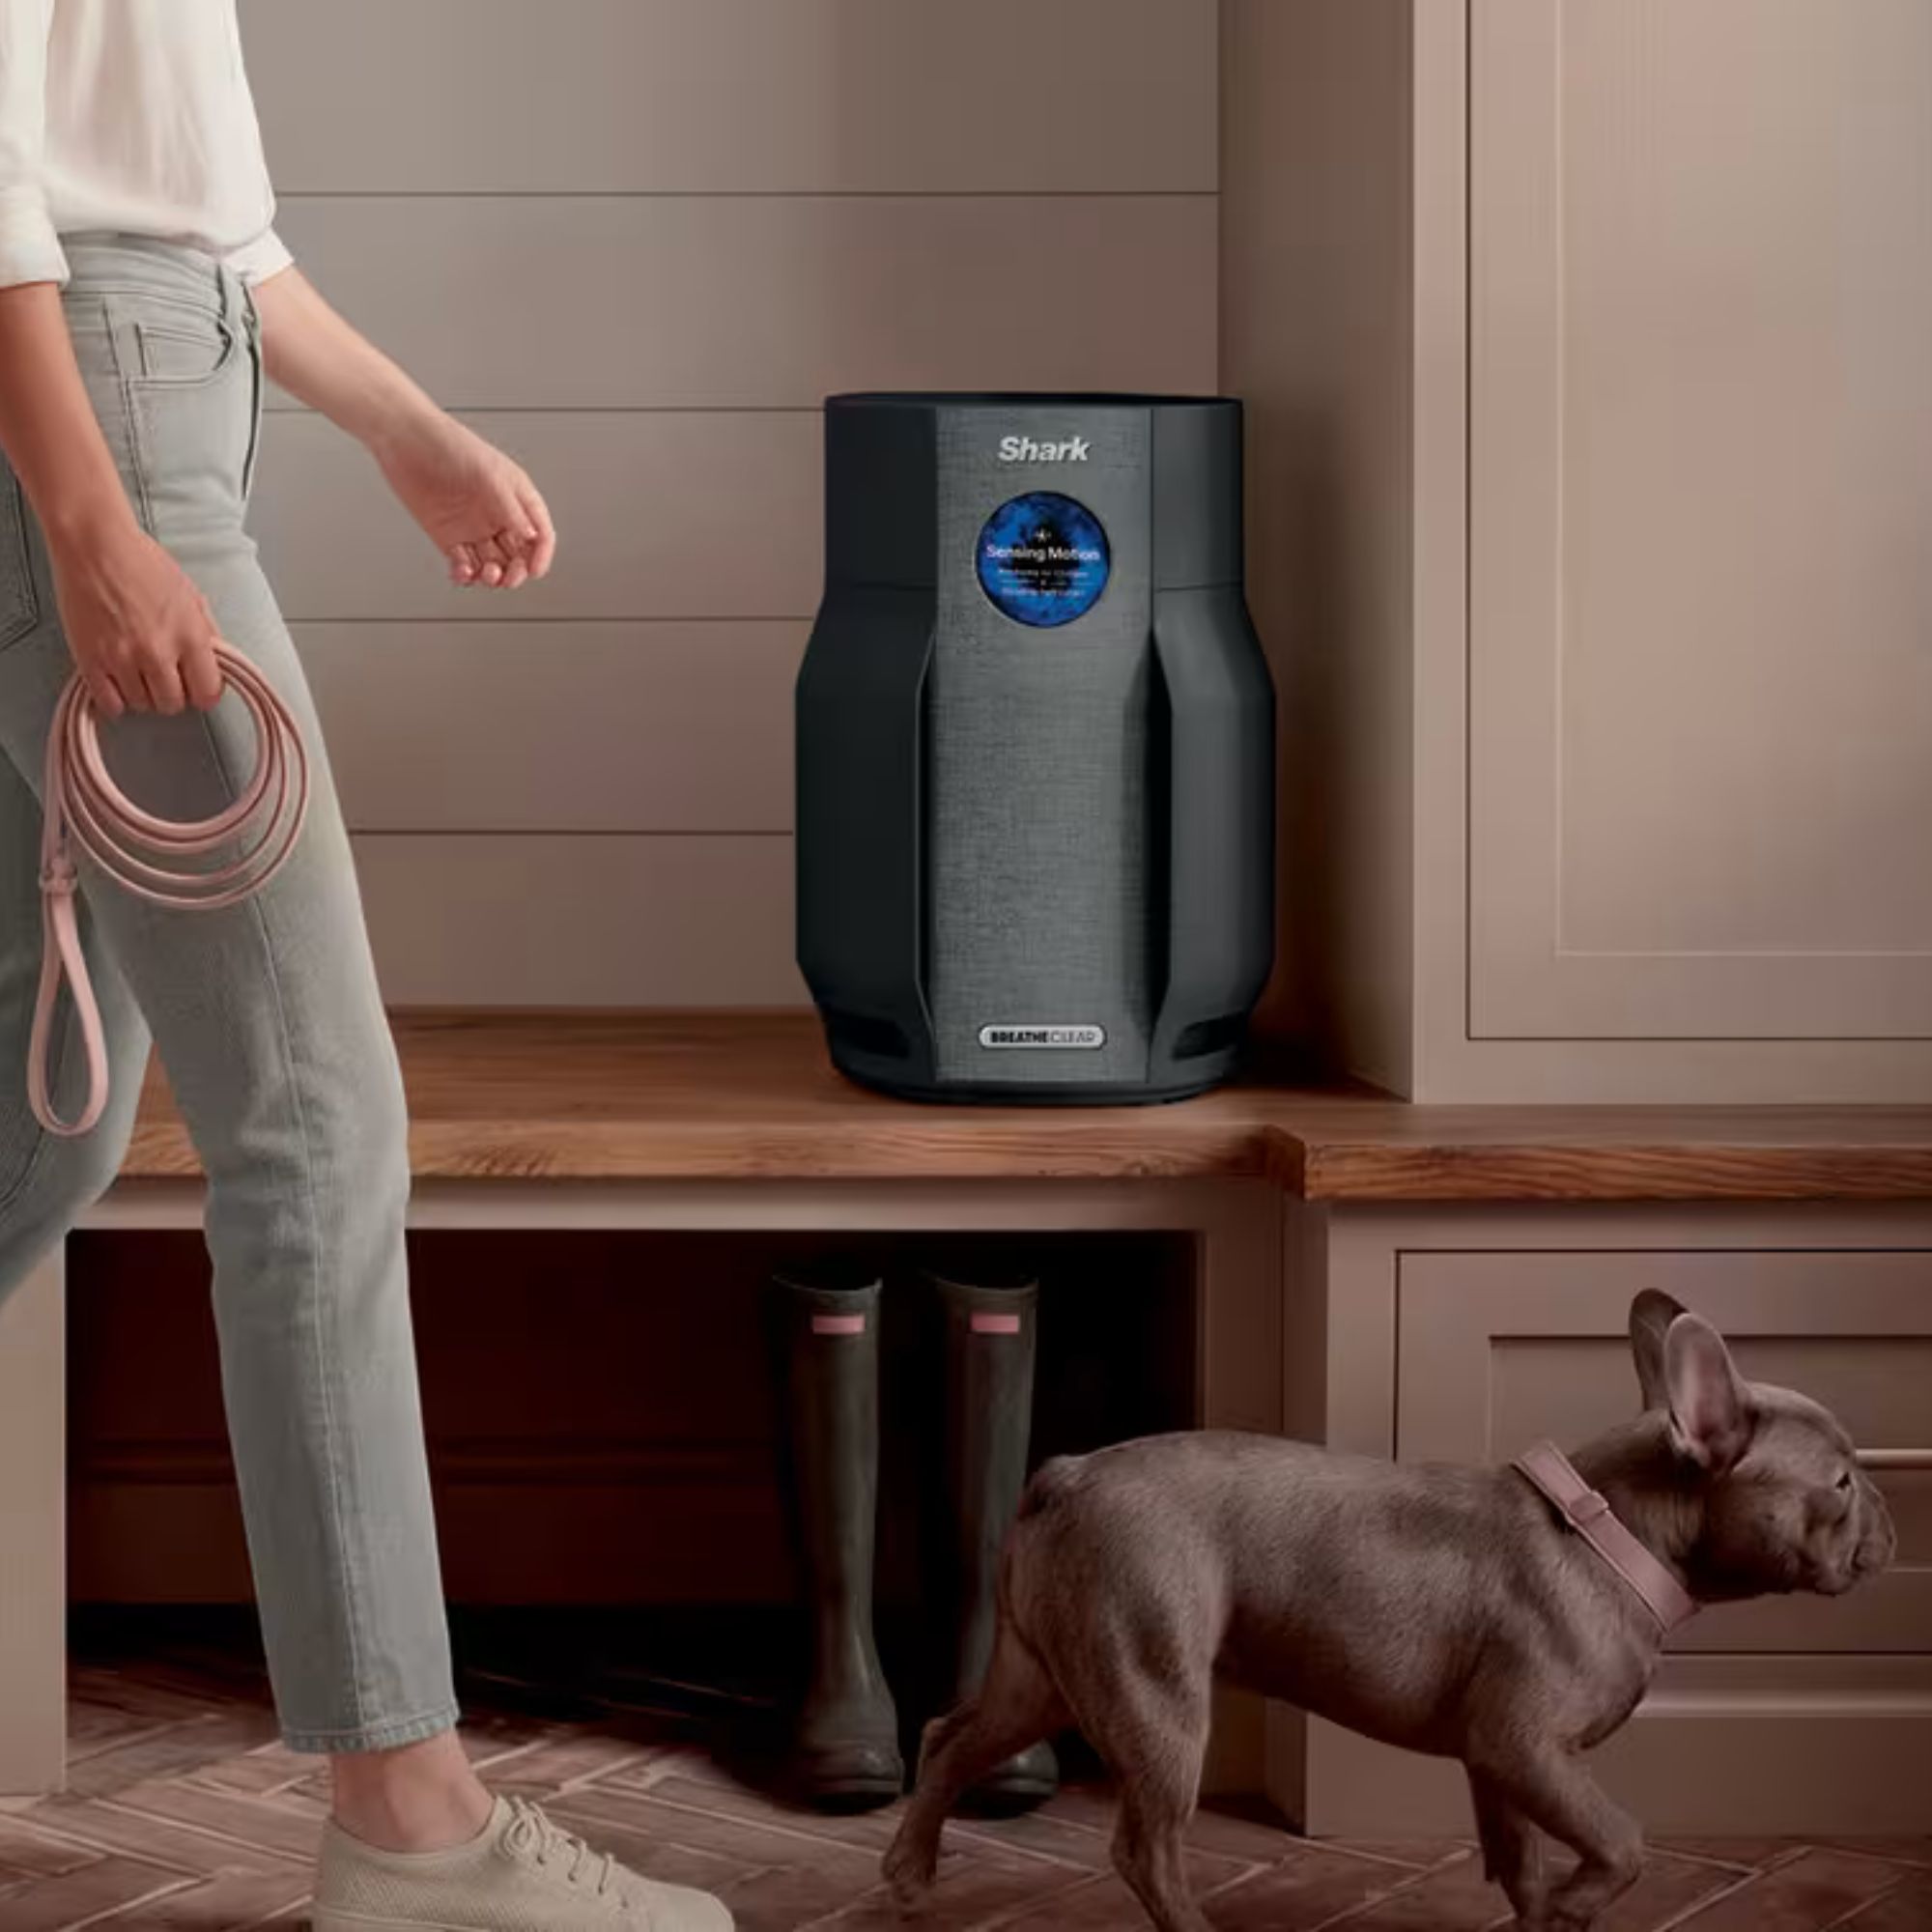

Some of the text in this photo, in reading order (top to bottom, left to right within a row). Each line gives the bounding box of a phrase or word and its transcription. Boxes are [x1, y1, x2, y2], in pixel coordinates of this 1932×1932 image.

[997, 436, 1091, 461] Shark
[986, 545, 1100, 562] Sensing Motion
